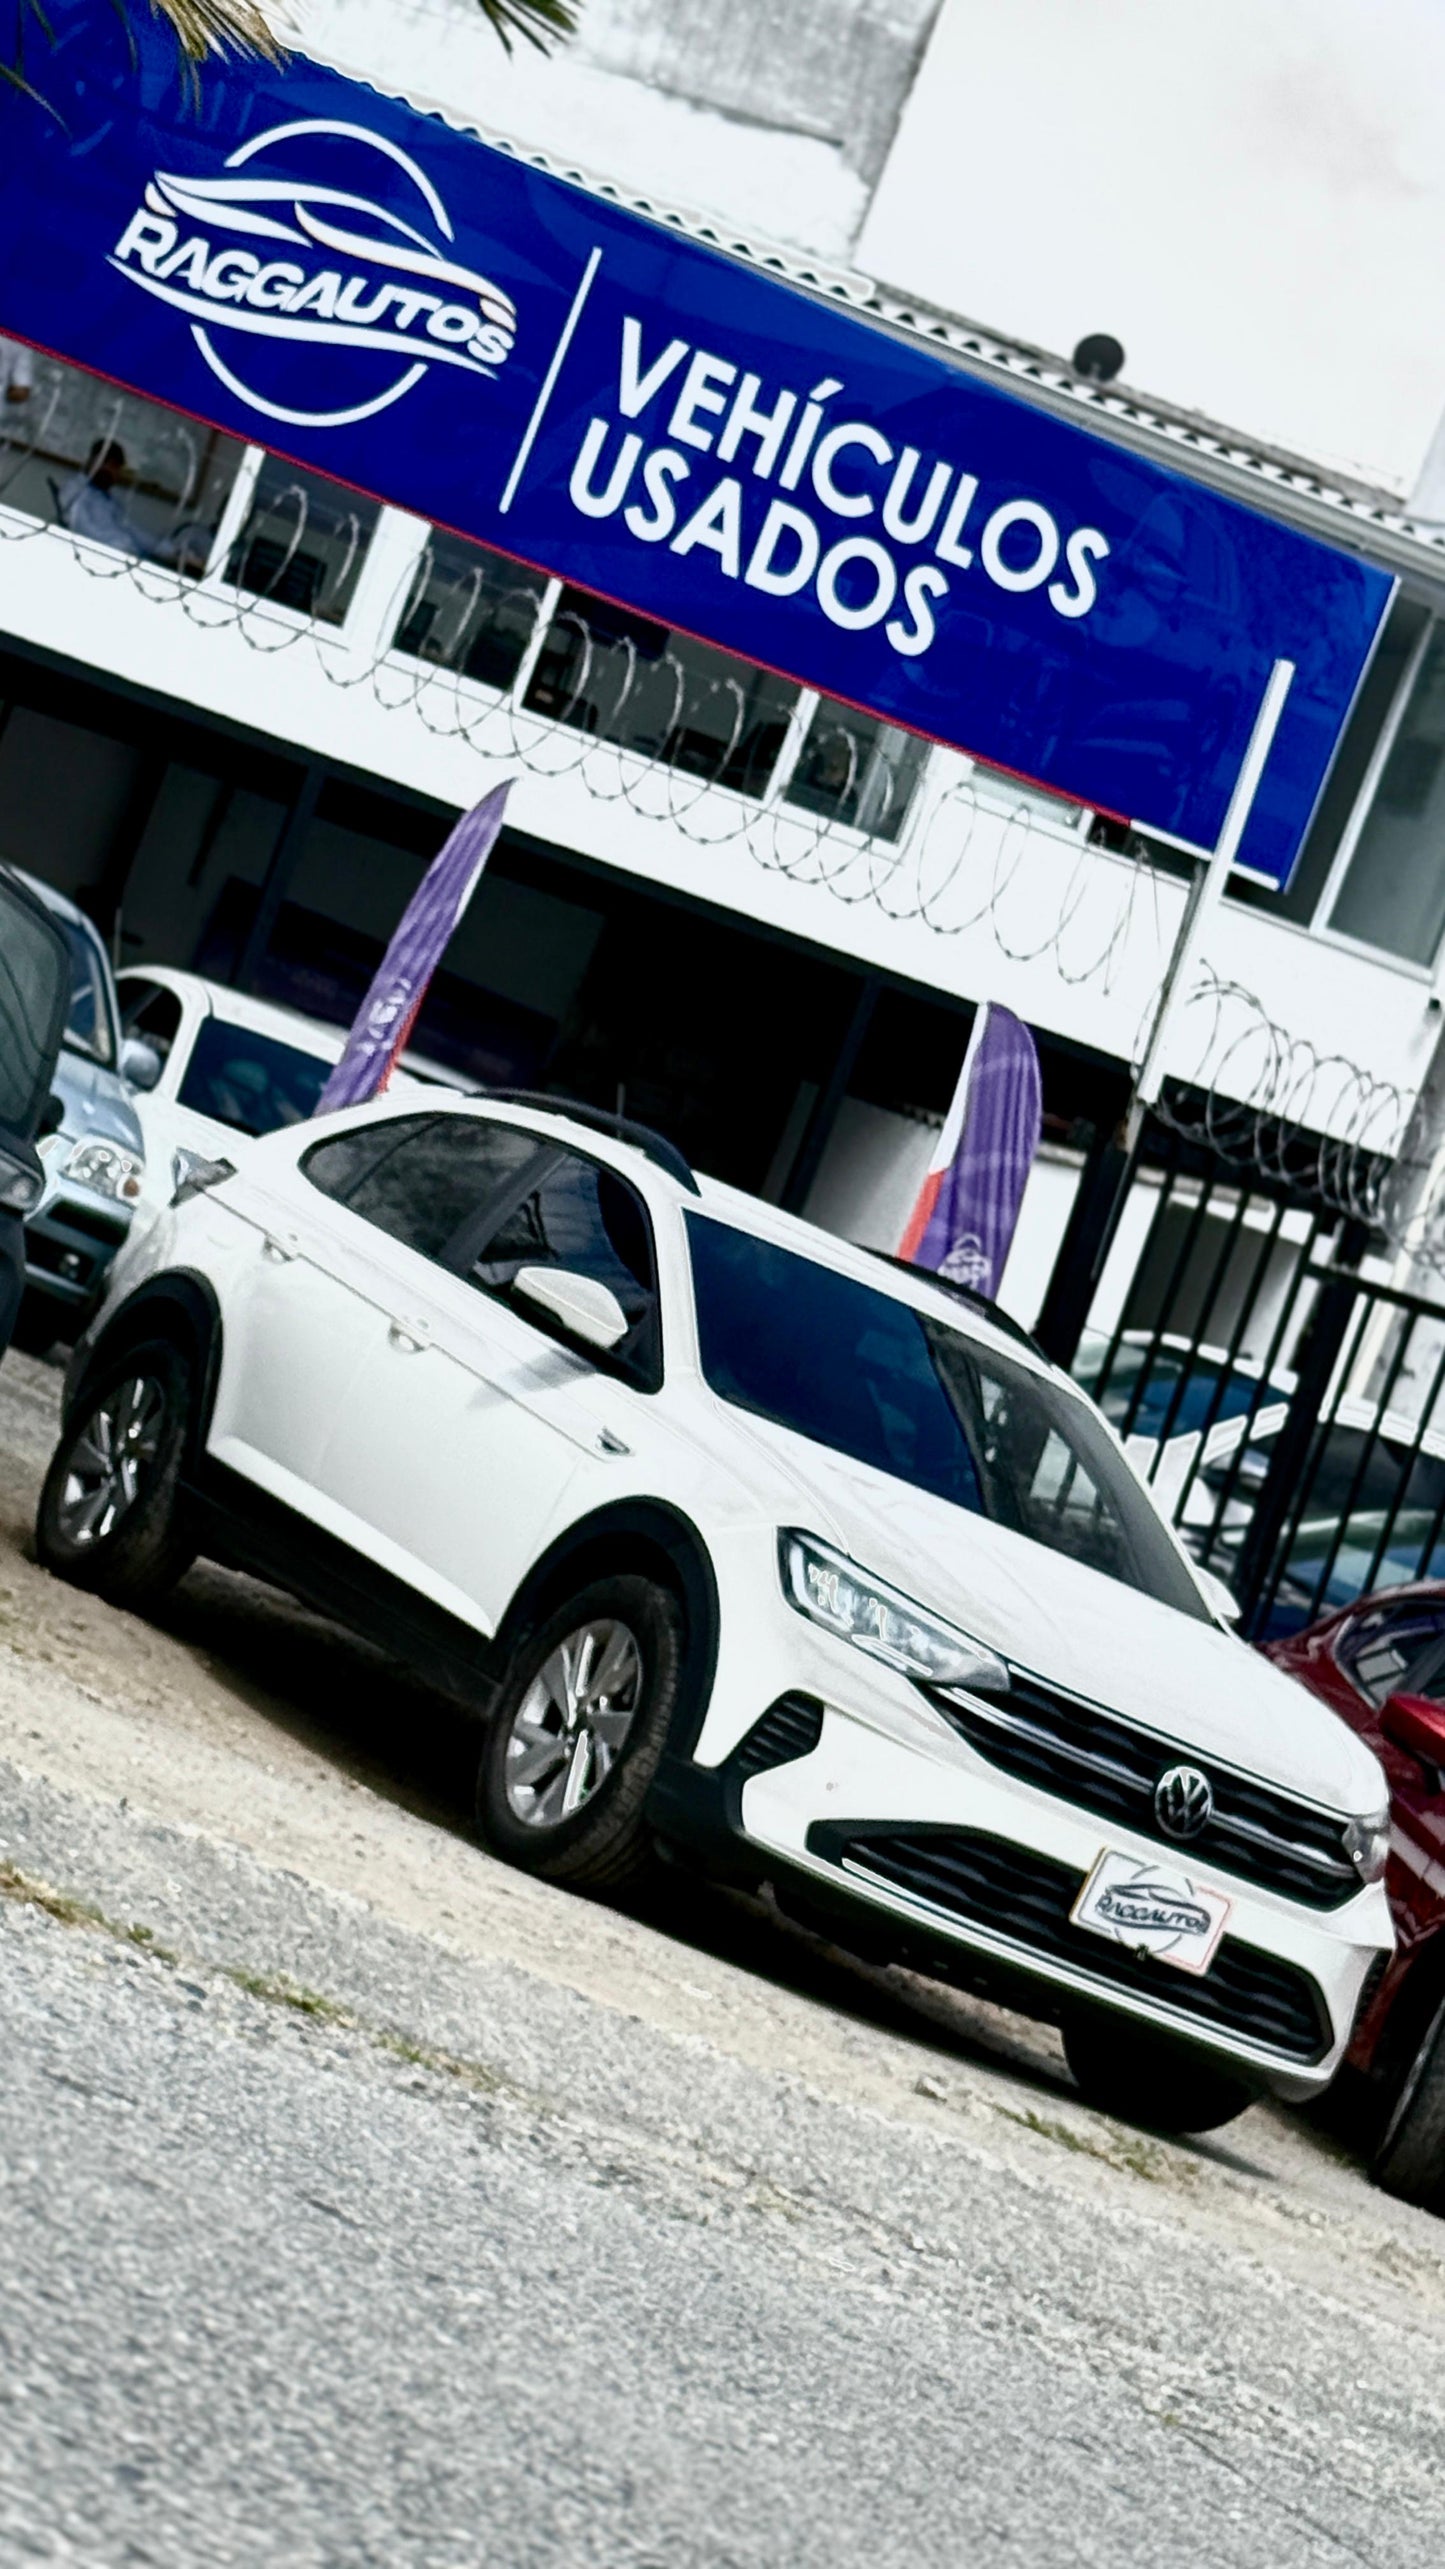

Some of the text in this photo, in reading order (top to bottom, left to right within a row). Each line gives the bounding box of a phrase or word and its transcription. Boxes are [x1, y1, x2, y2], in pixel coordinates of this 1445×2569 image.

[114, 208, 514, 364] RAGGAUTOS
[569, 418, 950, 657] USADOS
[620, 316, 1110, 618] VEHÍCULOS
